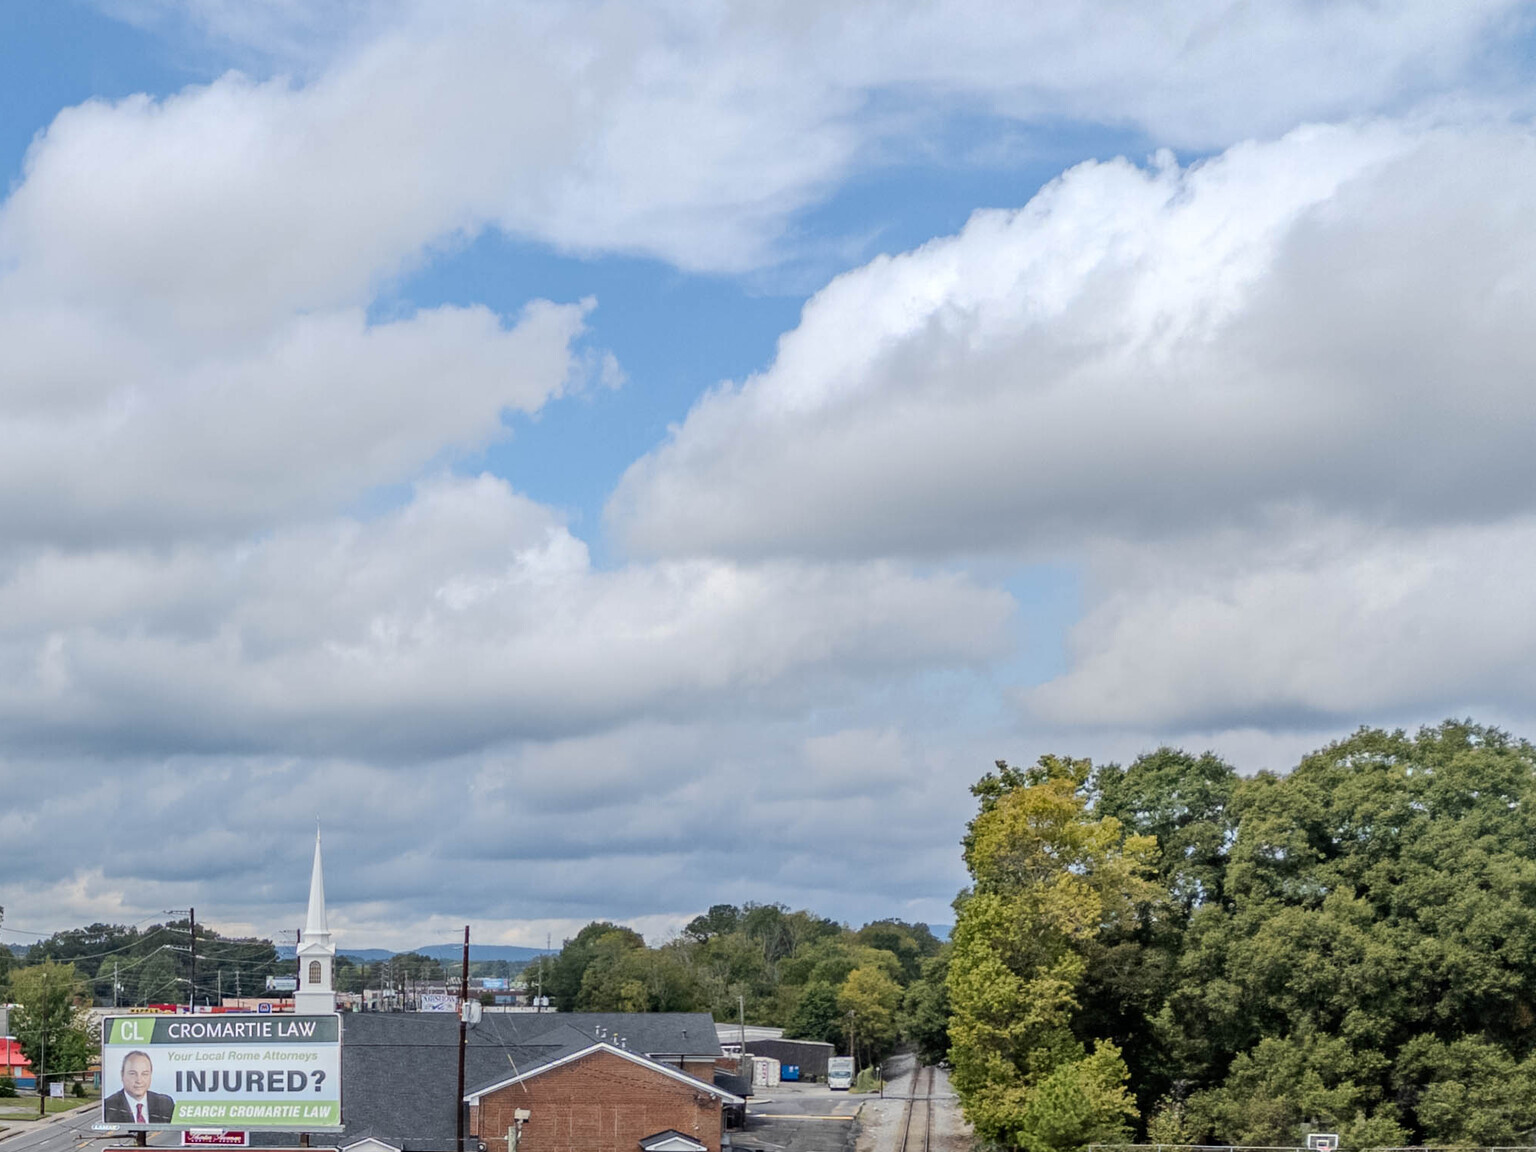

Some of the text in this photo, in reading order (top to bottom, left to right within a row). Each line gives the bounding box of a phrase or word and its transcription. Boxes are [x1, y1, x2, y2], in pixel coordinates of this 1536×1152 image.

[120, 1021, 144, 1041] CL
[168, 1021, 316, 1038] CROMARTIE LAW
[167, 1051, 318, 1062] Your Local Rome Attorneys
[175, 1070, 326, 1093] INJURED?
[179, 1105, 332, 1118] SEARCH CROMARTIE LAW
